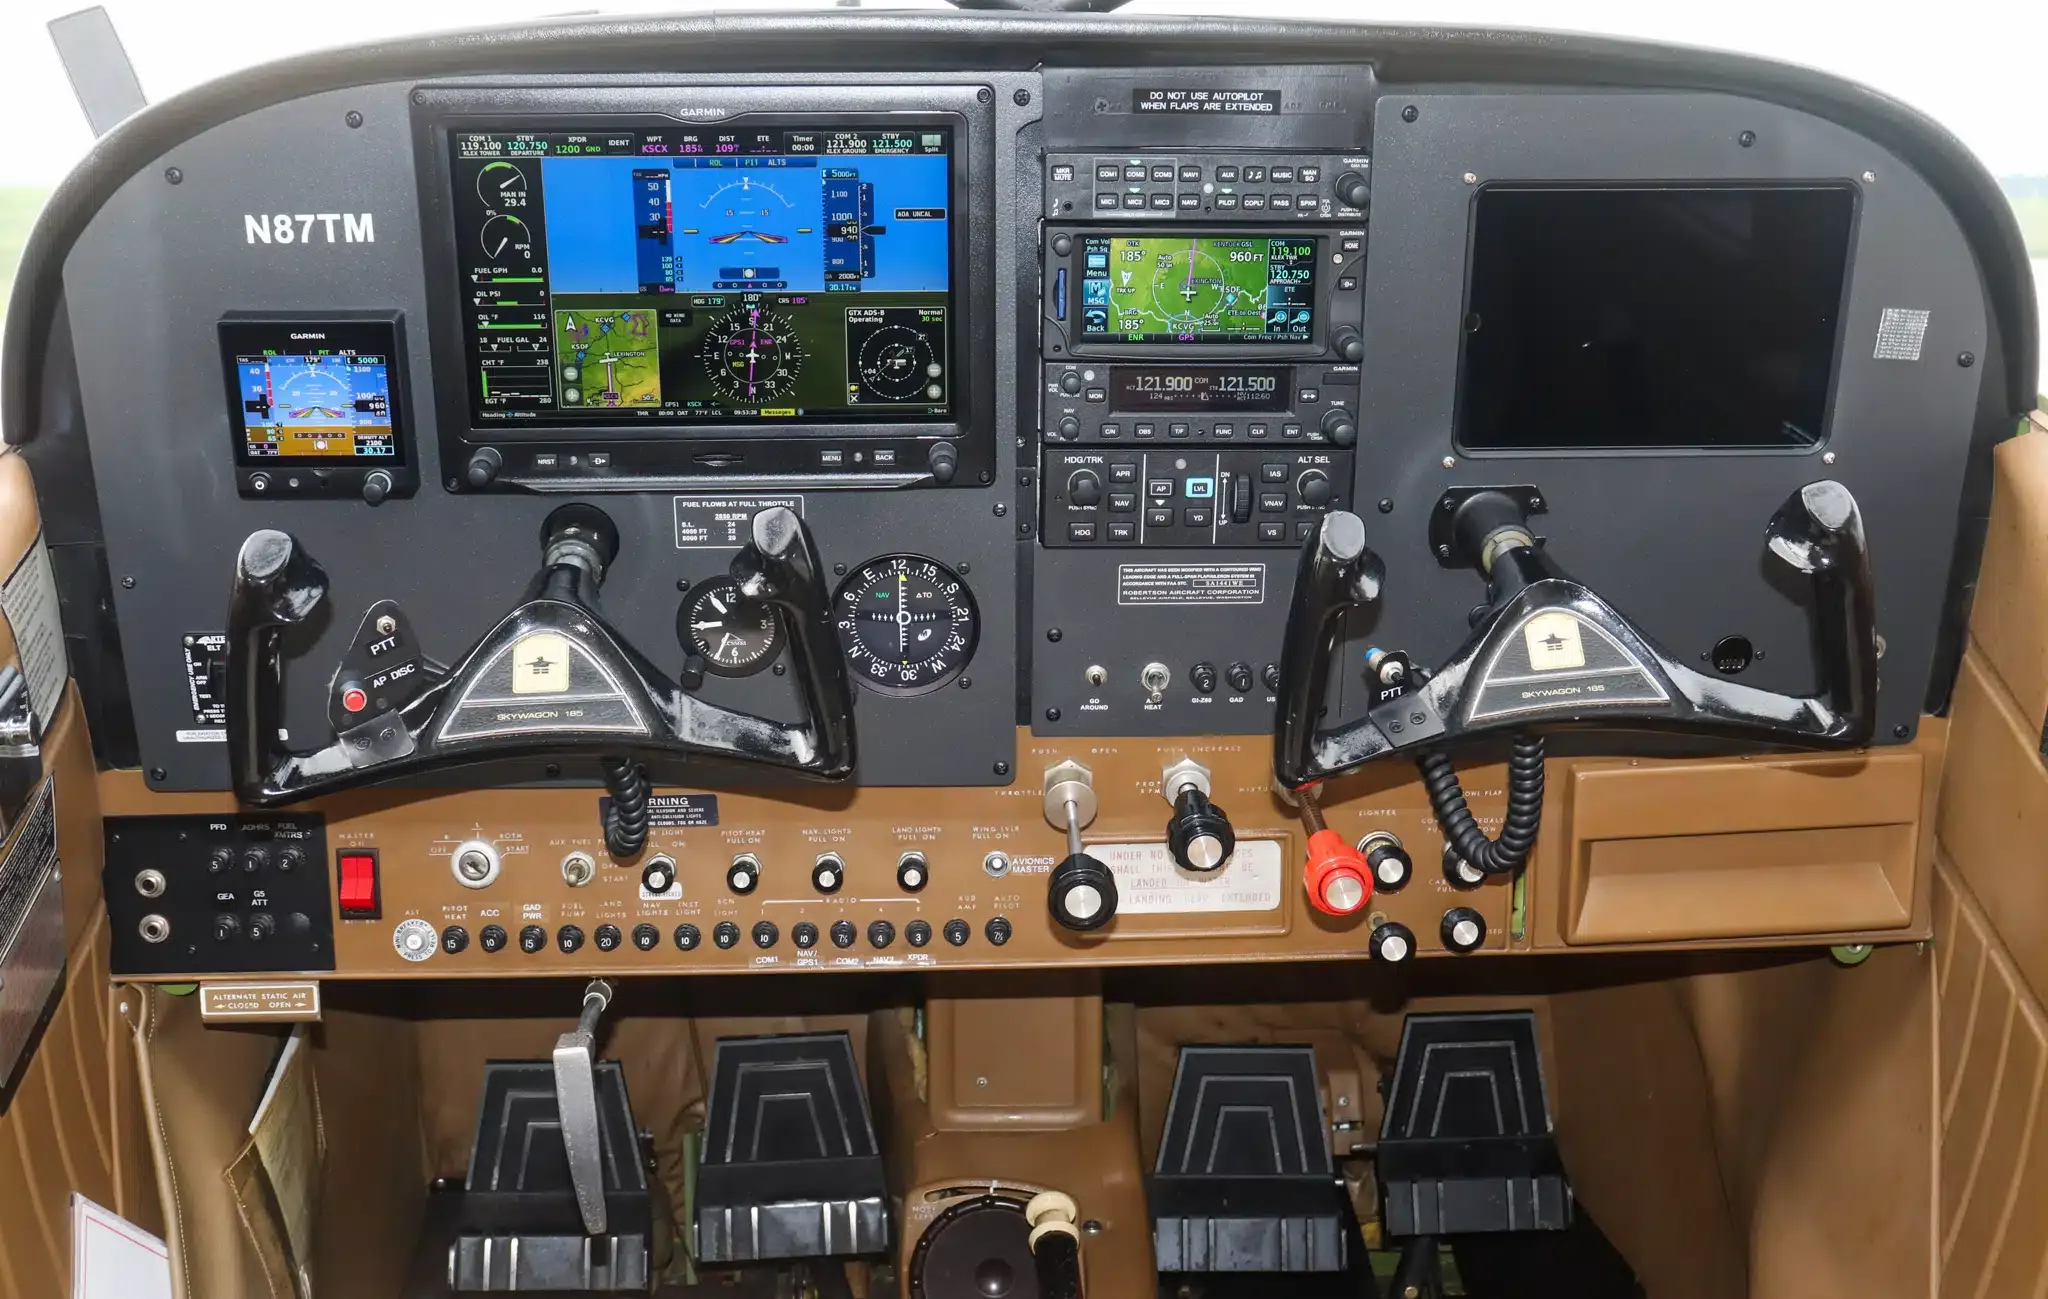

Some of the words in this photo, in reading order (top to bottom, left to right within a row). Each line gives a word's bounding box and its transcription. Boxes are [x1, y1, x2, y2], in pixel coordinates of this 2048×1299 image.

[1150, 92, 1163, 100] DO
[1168, 92, 1186, 100] NOT
[1191, 92, 1208, 100] USE
[1213, 92, 1263, 100] AUTOPILOT
[1141, 102, 1166, 110] WHEN
[1170, 102, 1199, 110] FLAPS
[1203, 102, 1221, 110] ARE
[1225, 103, 1272, 111] EXTENDED
[461, 142, 501, 150] 119.100
[507, 142, 547, 150] 120.750
[827, 140, 867, 148] 121.900
[872, 139, 912, 148] 121.500
[245, 213, 374, 243] N87TM
[1120, 251, 1146, 261] 185°
[1271, 247, 1310, 256] 119.100
[1230, 252, 1251, 262] 960
[1270, 270, 1309, 279] 120.750
[1119, 319, 1144, 329] 185°
[1136, 377, 1192, 391] 121.900
[1219, 377, 1275, 391] 121.500
[1064, 456, 1103, 464] HDG/TRK
[1314, 456, 1330, 464] SEL
[891, 560, 906, 569] 12
[371, 637, 395, 655] PTT
[373, 677, 387, 688] AP
[390, 664, 415, 681] DISC
[1381, 686, 1403, 700] PTT
[1522, 688, 1580, 698] SKYWAGON
[497, 712, 558, 720] SKYWAGON
[1110, 851, 1141, 860] UNDER
[447, 940, 456, 948] 15
[601, 938, 611, 946] 20
